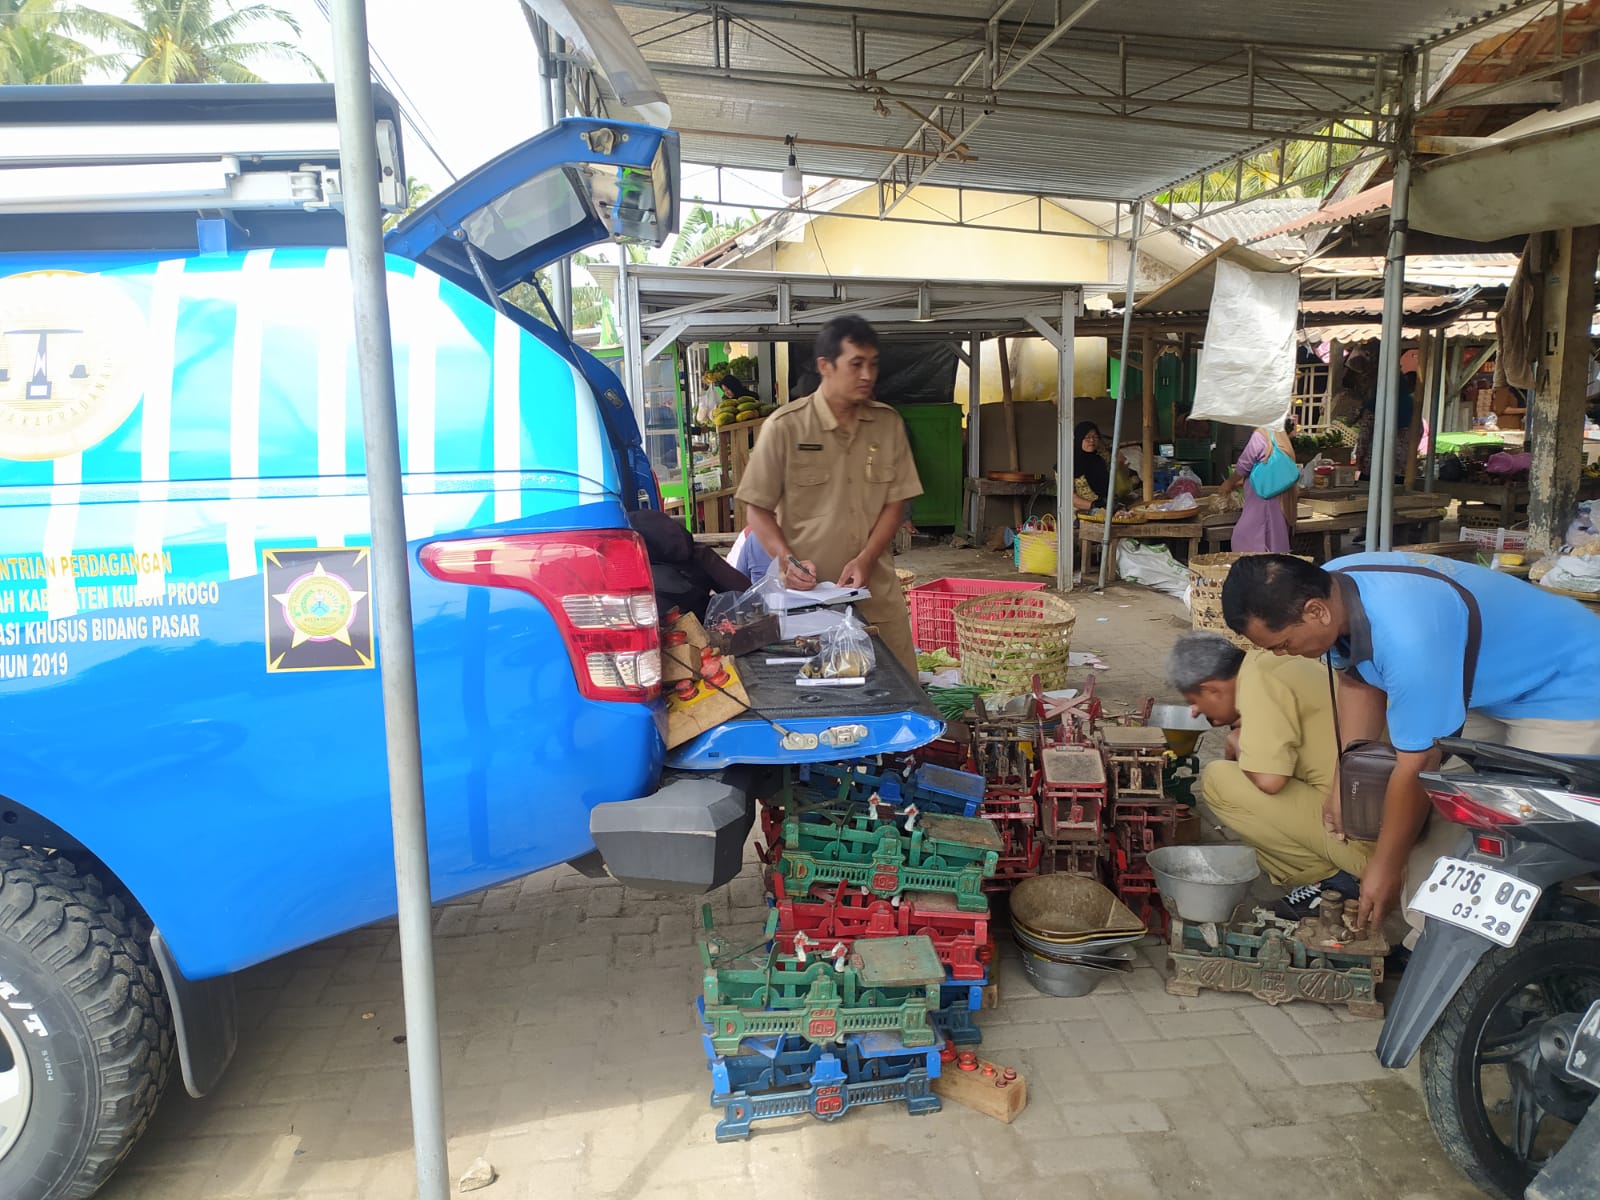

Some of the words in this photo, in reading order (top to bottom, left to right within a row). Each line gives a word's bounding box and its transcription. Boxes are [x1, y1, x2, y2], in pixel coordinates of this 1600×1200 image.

[60, 551, 173, 578] PERDAGANGAN
[19, 586, 109, 613] KABTEN
[167, 581, 219, 606] PROGO
[25, 618, 88, 645] KHUSUS
[91, 616, 148, 641] BIDANG
[152, 614, 201, 639] PASAR
[32, 651, 69, 677] 2019
[1439, 864, 1486, 895] 2736
